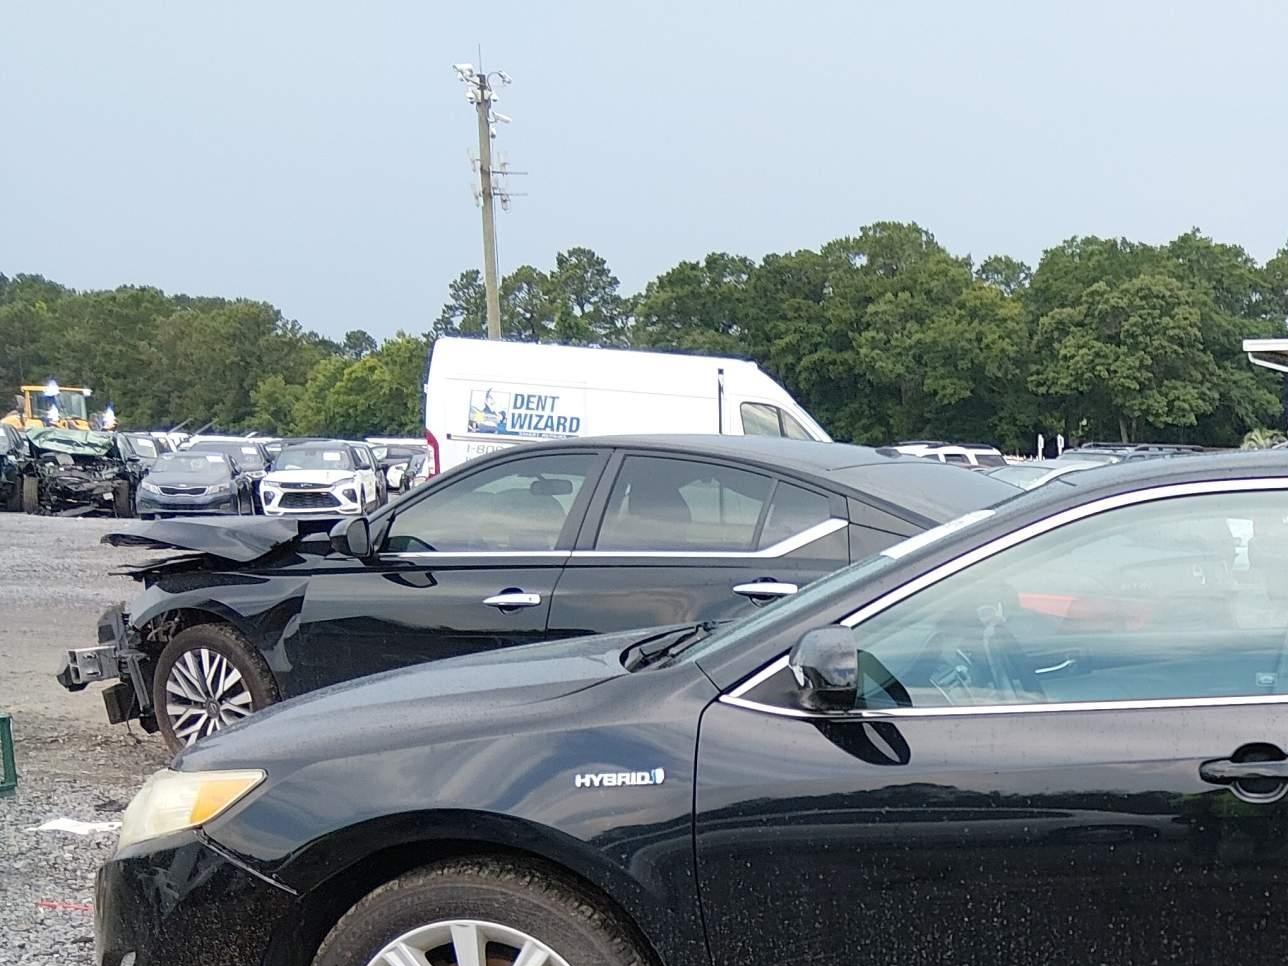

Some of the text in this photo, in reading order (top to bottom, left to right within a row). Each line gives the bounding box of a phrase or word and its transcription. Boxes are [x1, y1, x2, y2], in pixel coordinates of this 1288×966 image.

[512, 393, 560, 413] DENT
[510, 412, 580, 433] WIZARD
[575, 771, 651, 788] HYBRID
